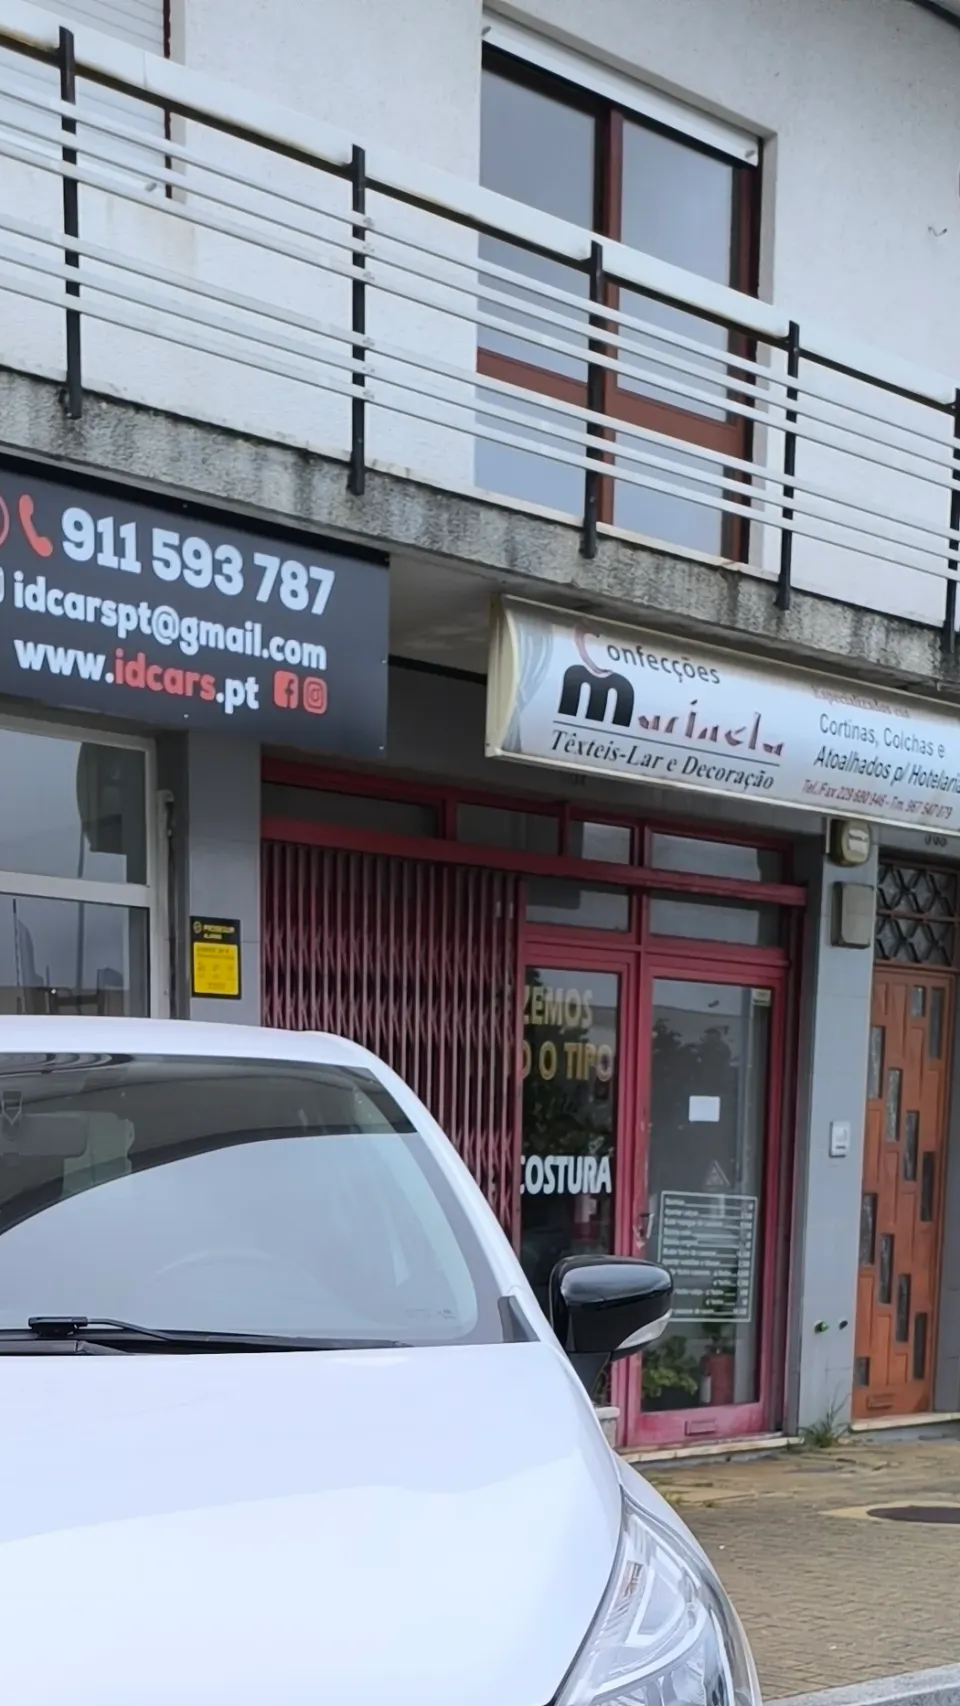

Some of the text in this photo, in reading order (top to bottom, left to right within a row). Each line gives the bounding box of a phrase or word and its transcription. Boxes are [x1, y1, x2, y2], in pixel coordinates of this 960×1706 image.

[60, 506, 336, 616] 911 593 787
[12, 570, 328, 671] idcarspt@gmail.com
[13, 638, 260, 715] www.idcars.pt
[551, 729, 775, 792] Têxteis-Lar e Decoração
[813, 745, 892, 780] Atoalhados
[819, 713, 946, 759] Cortinas, Colchas e
[539, 1040, 558, 1081] O
[563, 1041, 614, 1082] TIPO
[520, 1155, 613, 1195] OSTURA
